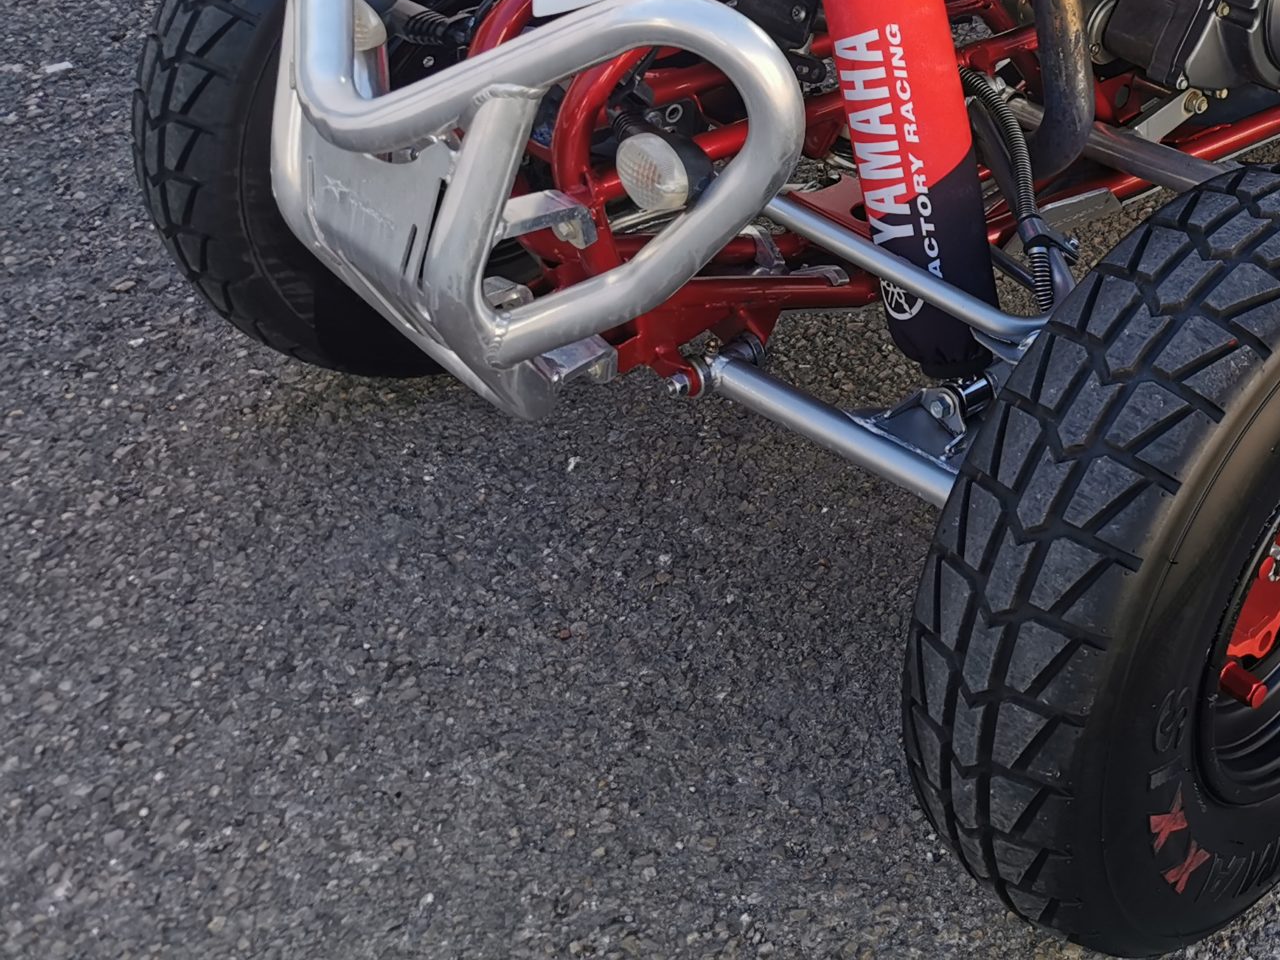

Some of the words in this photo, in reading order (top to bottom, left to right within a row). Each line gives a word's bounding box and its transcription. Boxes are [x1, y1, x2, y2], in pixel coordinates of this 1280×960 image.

[834, 28, 915, 246] YAMAHA
[885, 23, 921, 143] RACING
[908, 153, 944, 279] ACTORY
